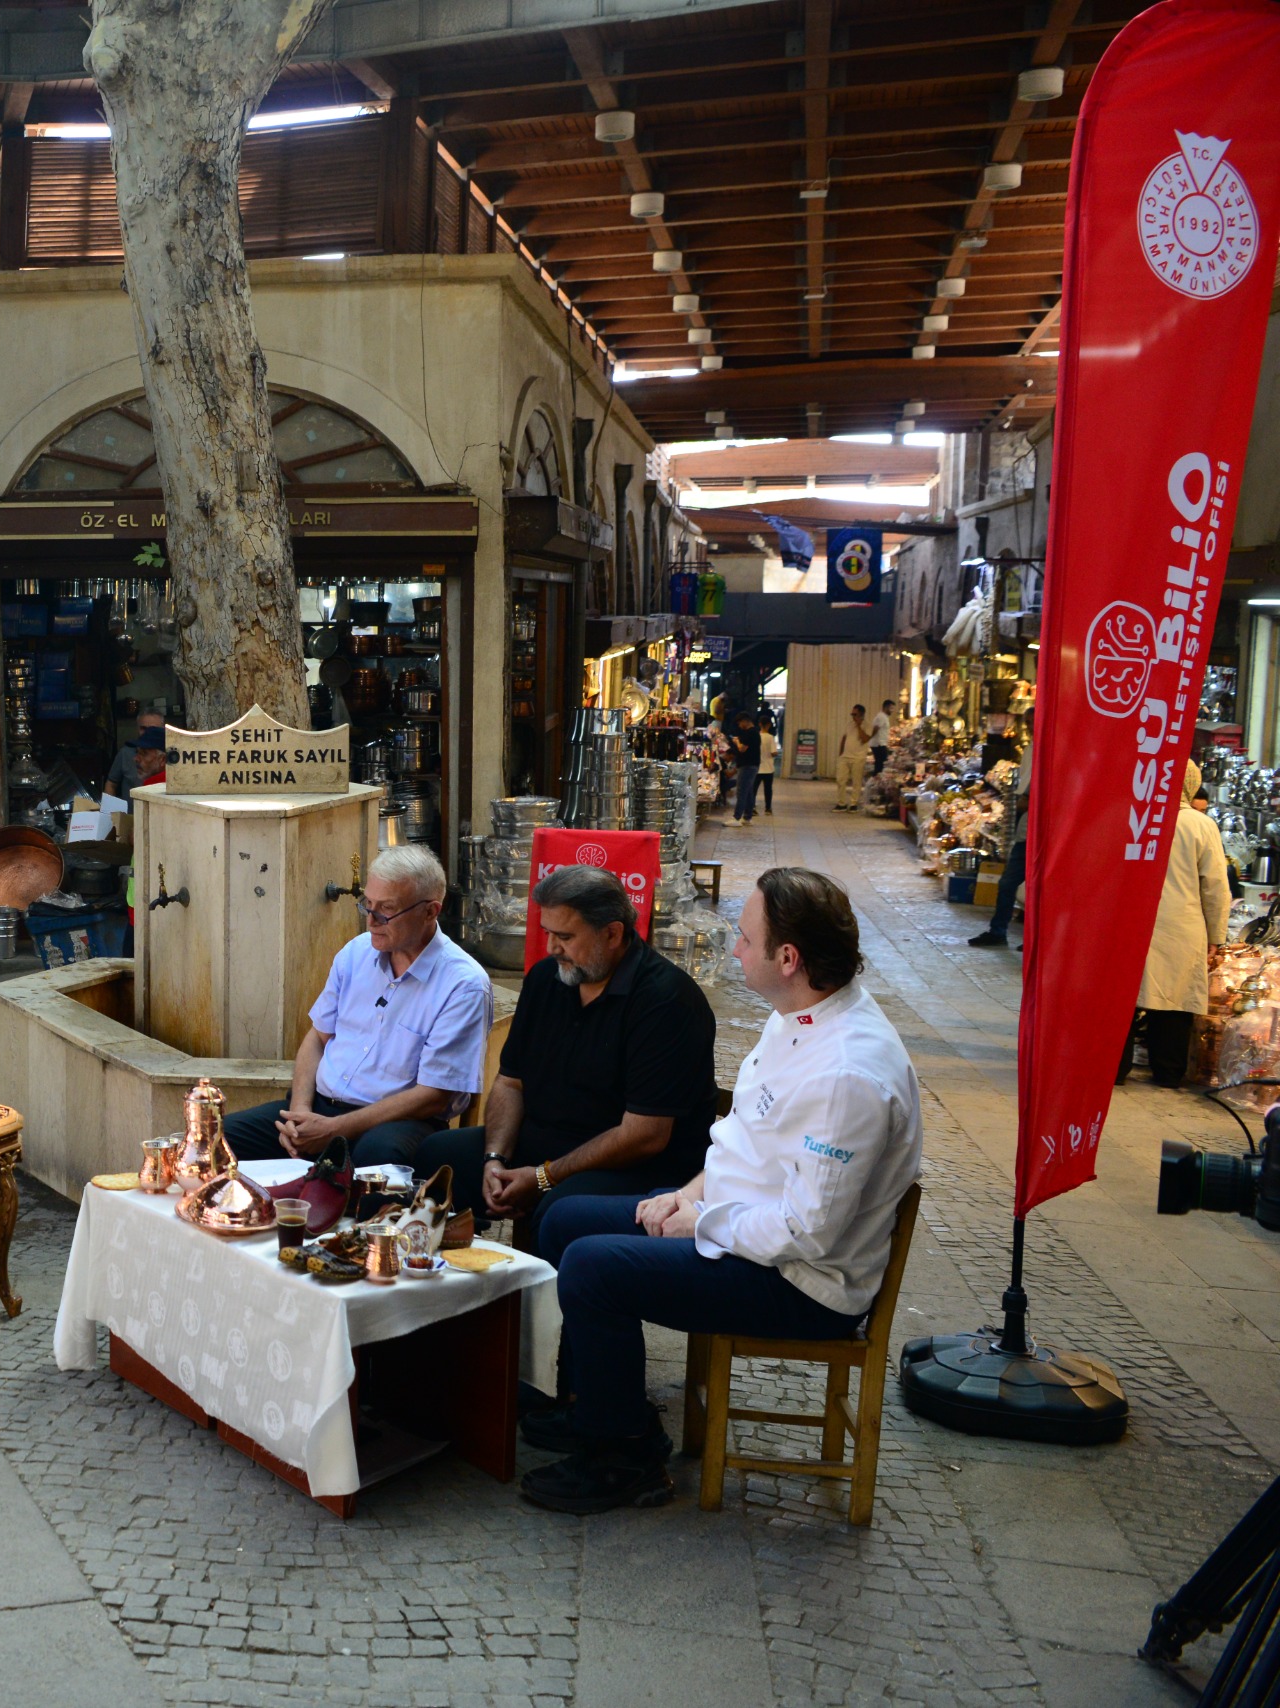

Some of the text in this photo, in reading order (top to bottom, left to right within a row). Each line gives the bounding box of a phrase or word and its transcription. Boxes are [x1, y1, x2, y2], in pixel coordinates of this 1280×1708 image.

[1191, 147, 1213, 162] T.C.
[1179, 215, 1220, 236] 1992
[1144, 759, 1175, 861] BİLİM
[1204, 460, 1231, 561] OFİSİ
[166, 747, 347, 765] ÖMER FARUK SAYIL
[217, 770, 297, 785] ANISINA
[1125, 697, 1167, 860] KSÜ
[803, 1135, 855, 1165] Turkey
